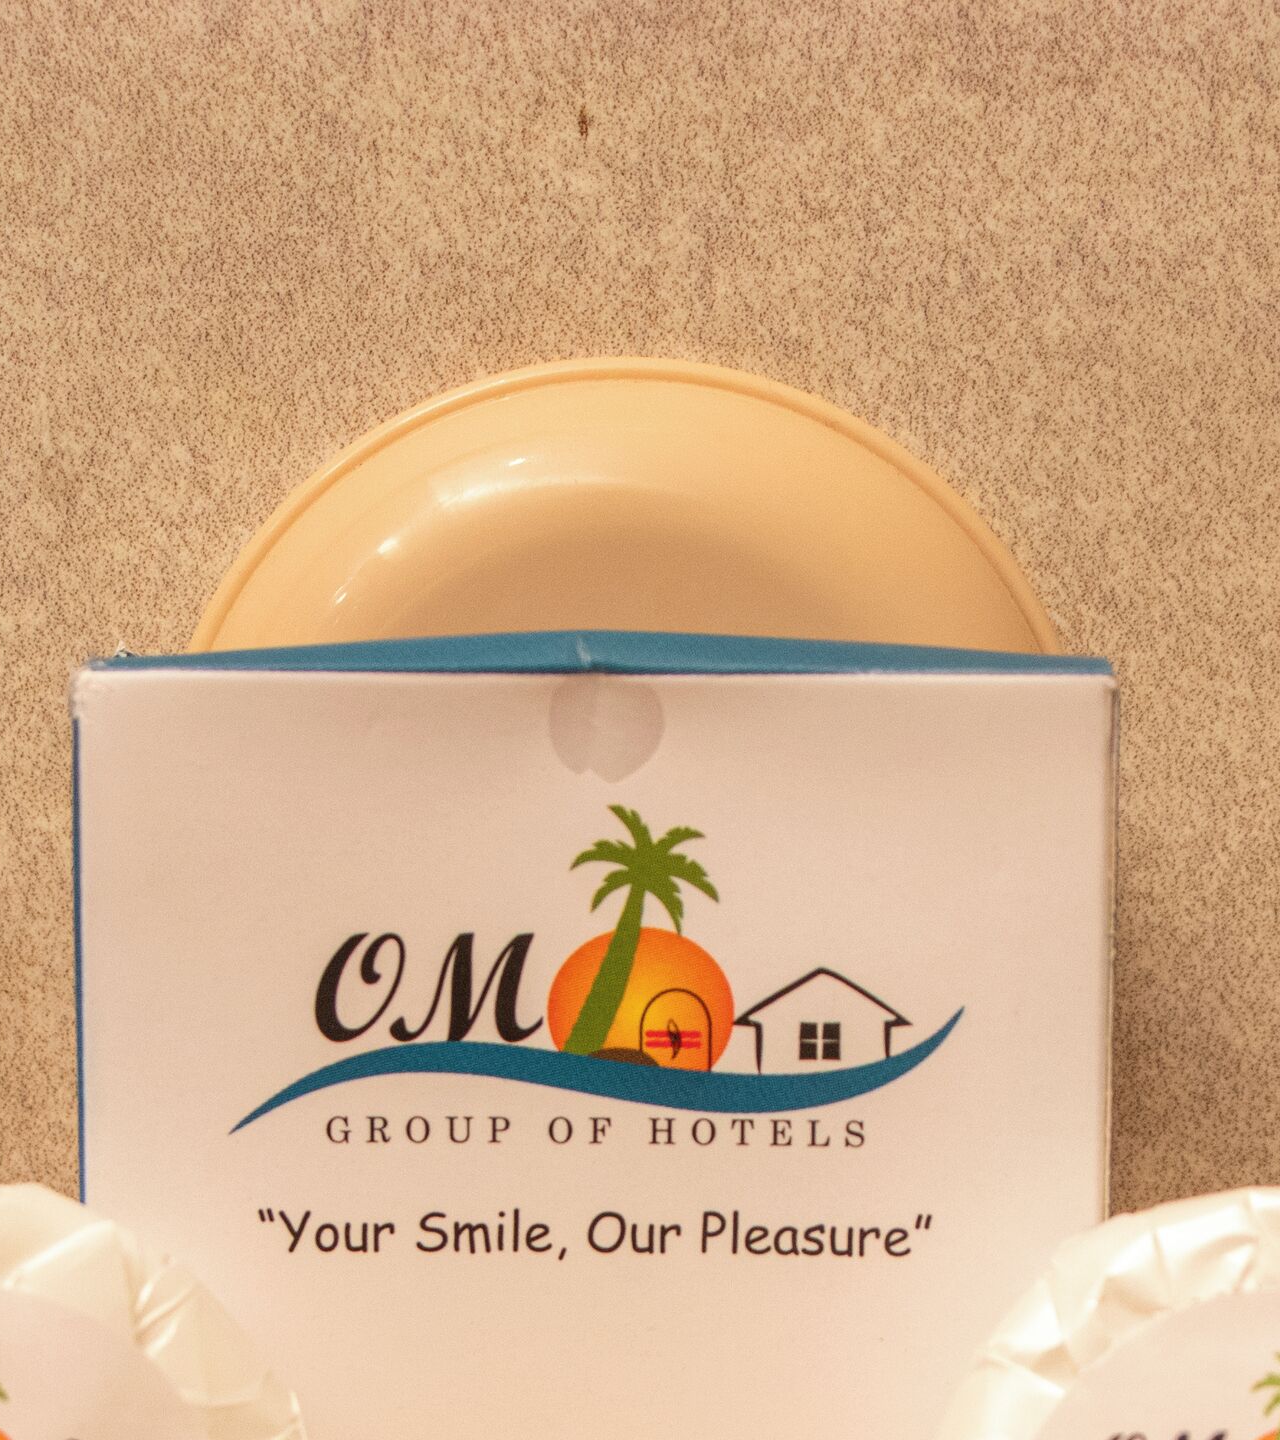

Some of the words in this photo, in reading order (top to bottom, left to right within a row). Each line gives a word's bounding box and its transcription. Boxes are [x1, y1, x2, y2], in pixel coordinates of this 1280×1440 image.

[313, 931, 546, 1044] OM
[325, 1115, 512, 1145] GROUP
[548, 1116, 612, 1145] OF
[649, 1117, 866, 1148] HOTELS
[415, 1207, 567, 1261] Smile,
[587, 1211, 682, 1255] Our
